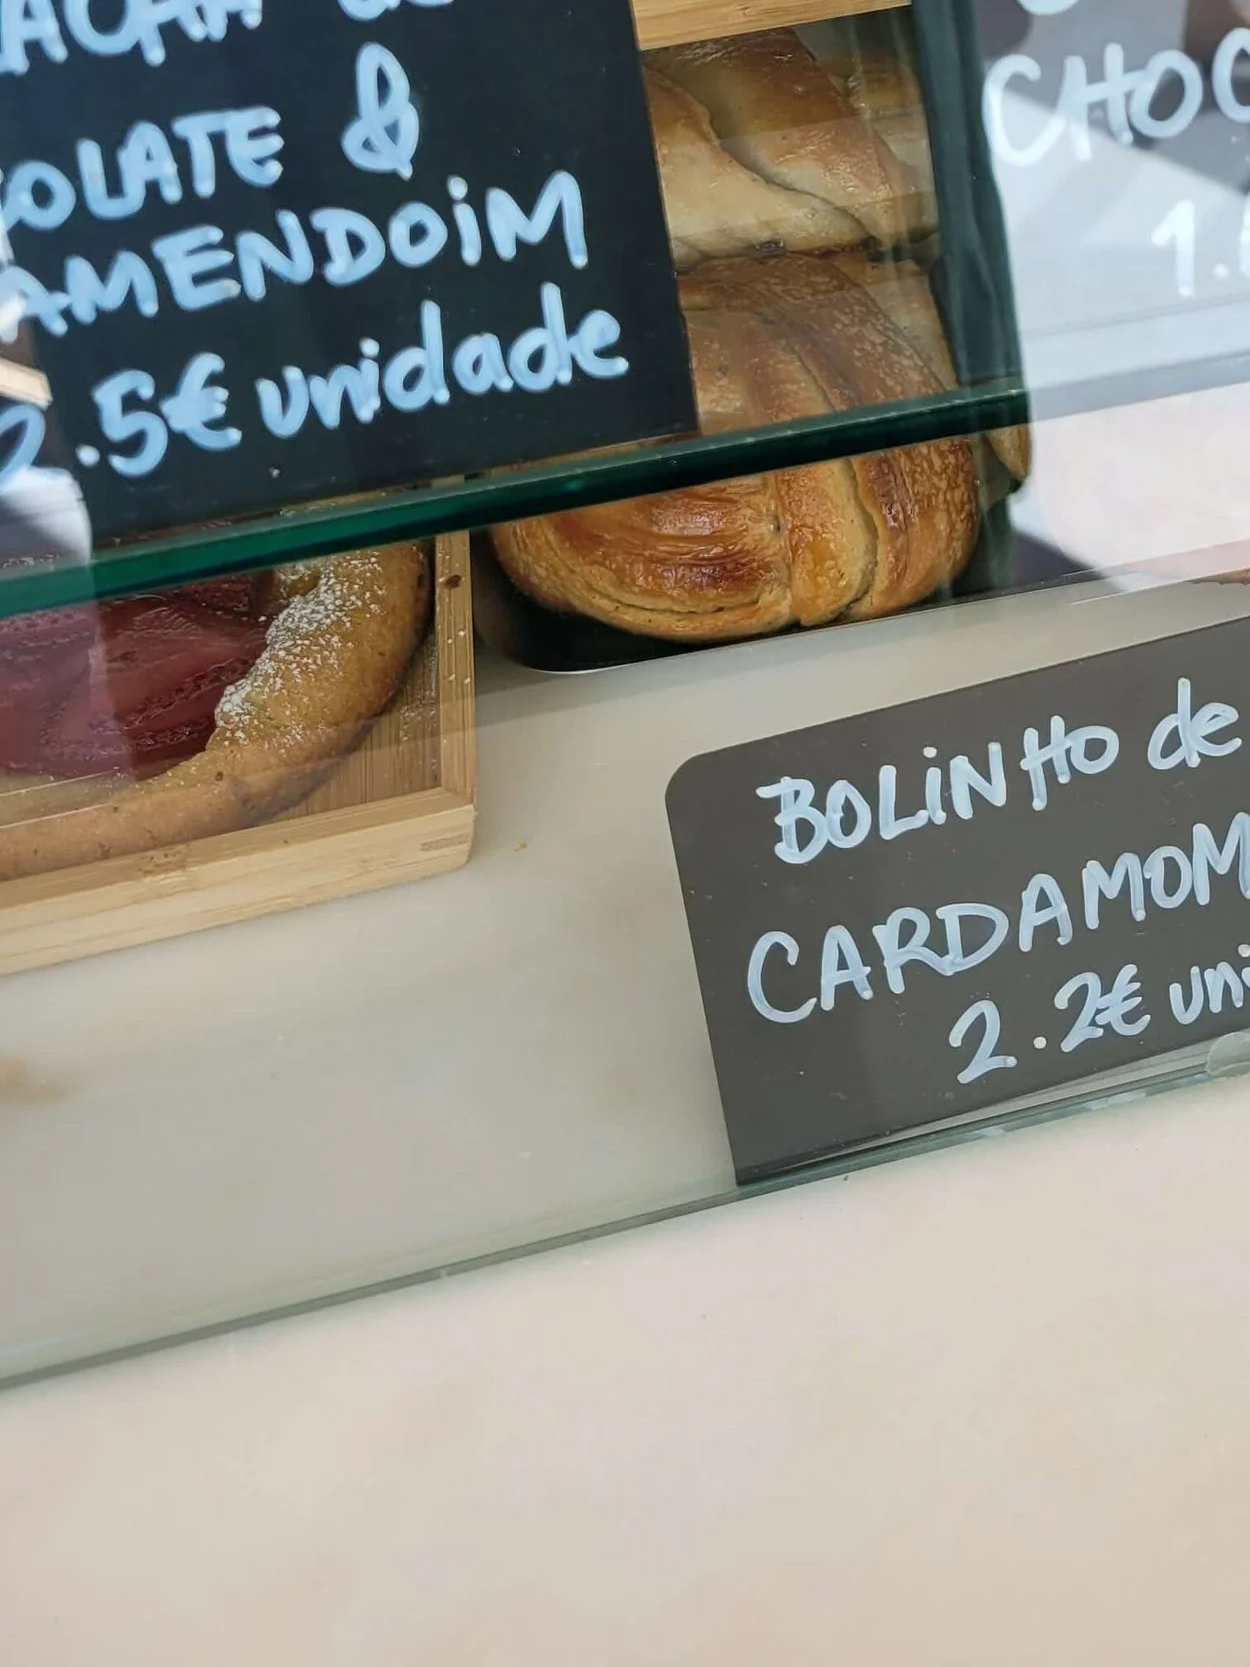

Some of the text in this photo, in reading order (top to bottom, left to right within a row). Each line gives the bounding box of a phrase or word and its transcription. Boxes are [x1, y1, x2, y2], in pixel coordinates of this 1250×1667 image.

[0, 105, 284, 231] OLATE
[255, 281, 630, 436] unidade
[1147, 677, 1242, 770] de
[948, 964, 1150, 1084] 2.2€
